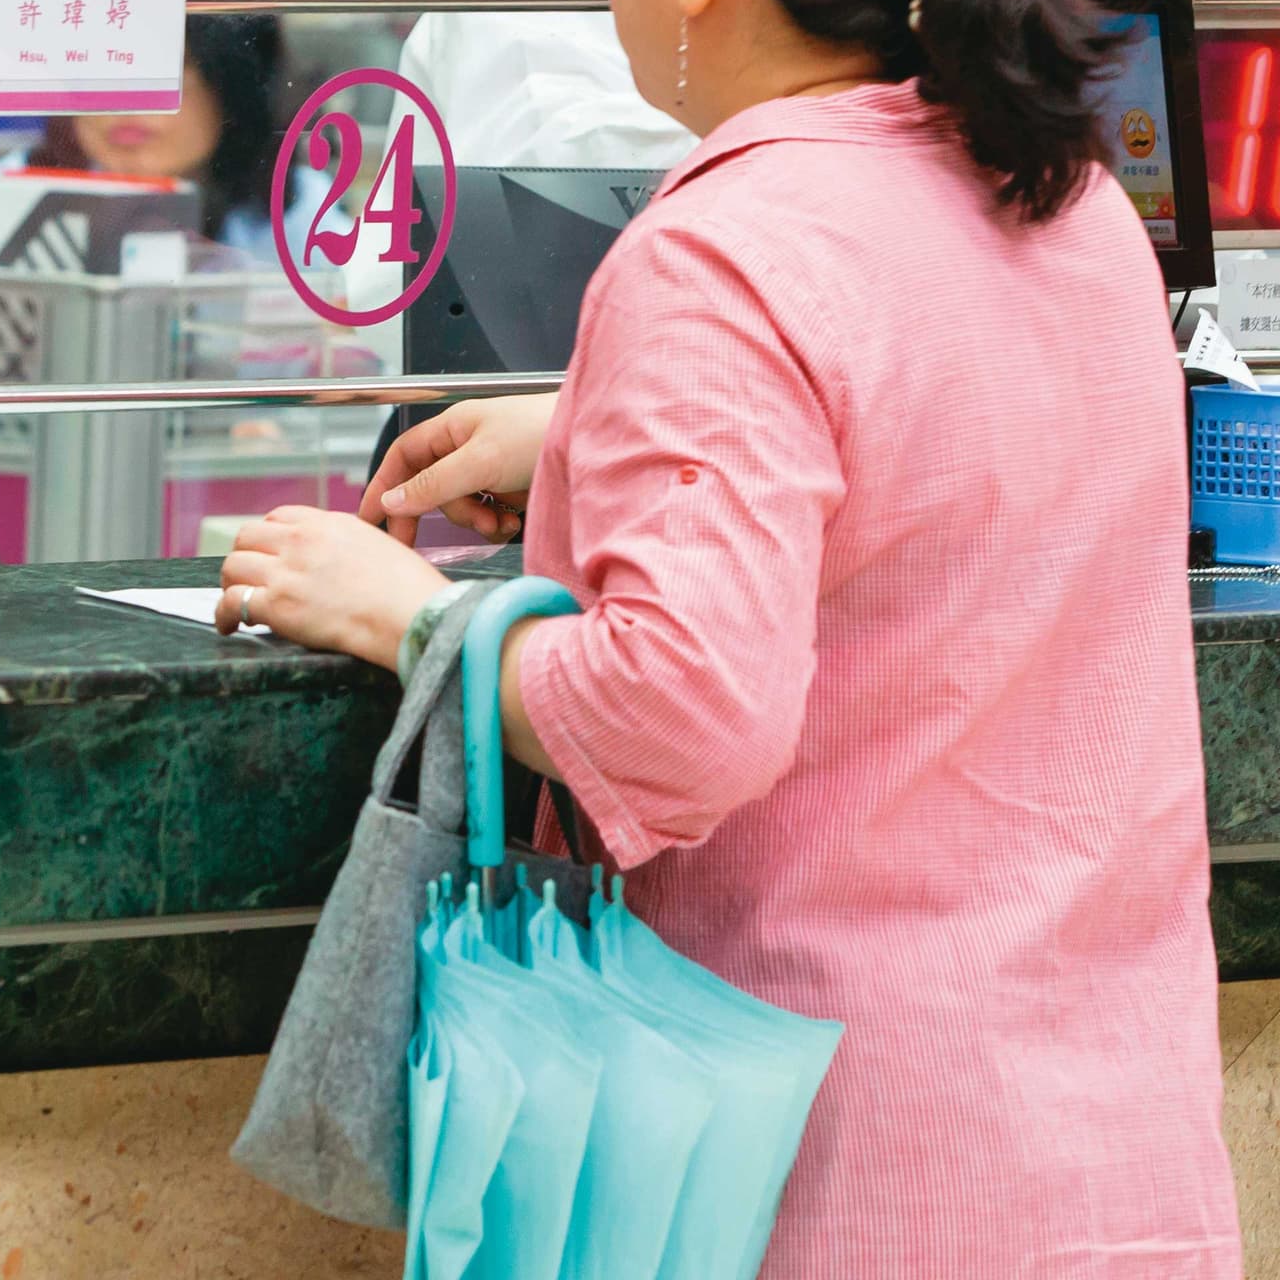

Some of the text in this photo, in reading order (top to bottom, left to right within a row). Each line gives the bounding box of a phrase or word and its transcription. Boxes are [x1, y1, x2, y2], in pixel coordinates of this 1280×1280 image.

[19, 50, 134, 65] Hsu, Wei Ting
[303, 112, 422, 266] 24
